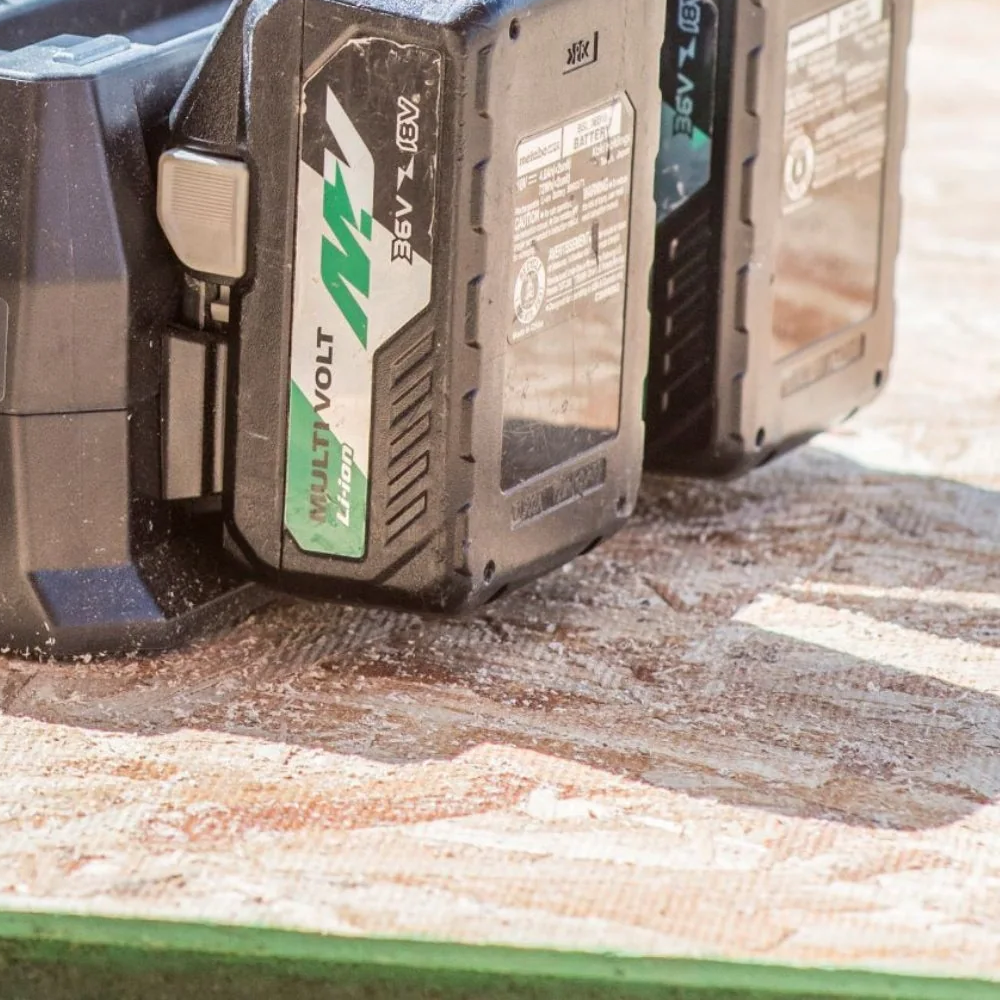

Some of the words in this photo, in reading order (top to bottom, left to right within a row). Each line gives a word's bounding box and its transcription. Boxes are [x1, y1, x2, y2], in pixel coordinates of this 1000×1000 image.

[395, 96, 420, 152] 18V
[672, 72, 695, 138] 36V
[391, 195, 413, 265] 36V
[313, 326, 335, 414] VOLT
[309, 421, 331, 523] MULTI
[336, 442, 355, 528] Li-ion
